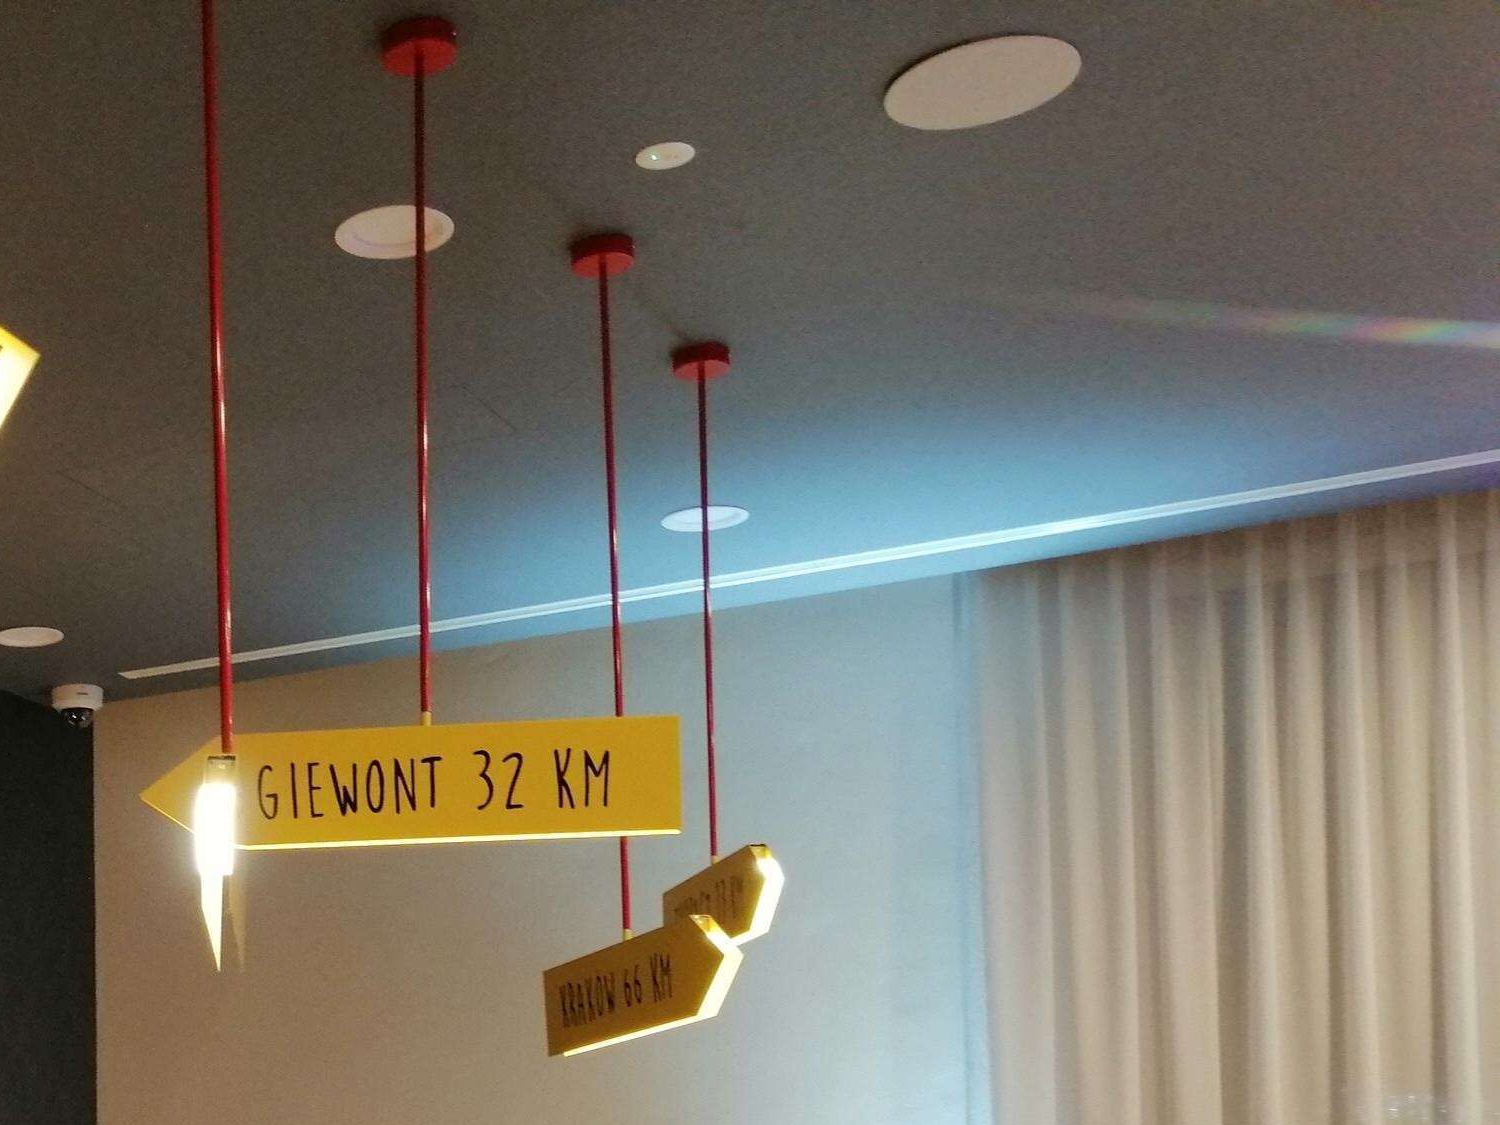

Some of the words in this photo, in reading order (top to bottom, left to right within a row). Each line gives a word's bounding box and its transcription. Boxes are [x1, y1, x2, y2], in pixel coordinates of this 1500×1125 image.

[257, 755, 443, 820] GIEWONT
[472, 749, 525, 811] 32
[553, 747, 612, 809] KM
[623, 966, 643, 1008] 66
[649, 952, 673, 1003] KM
